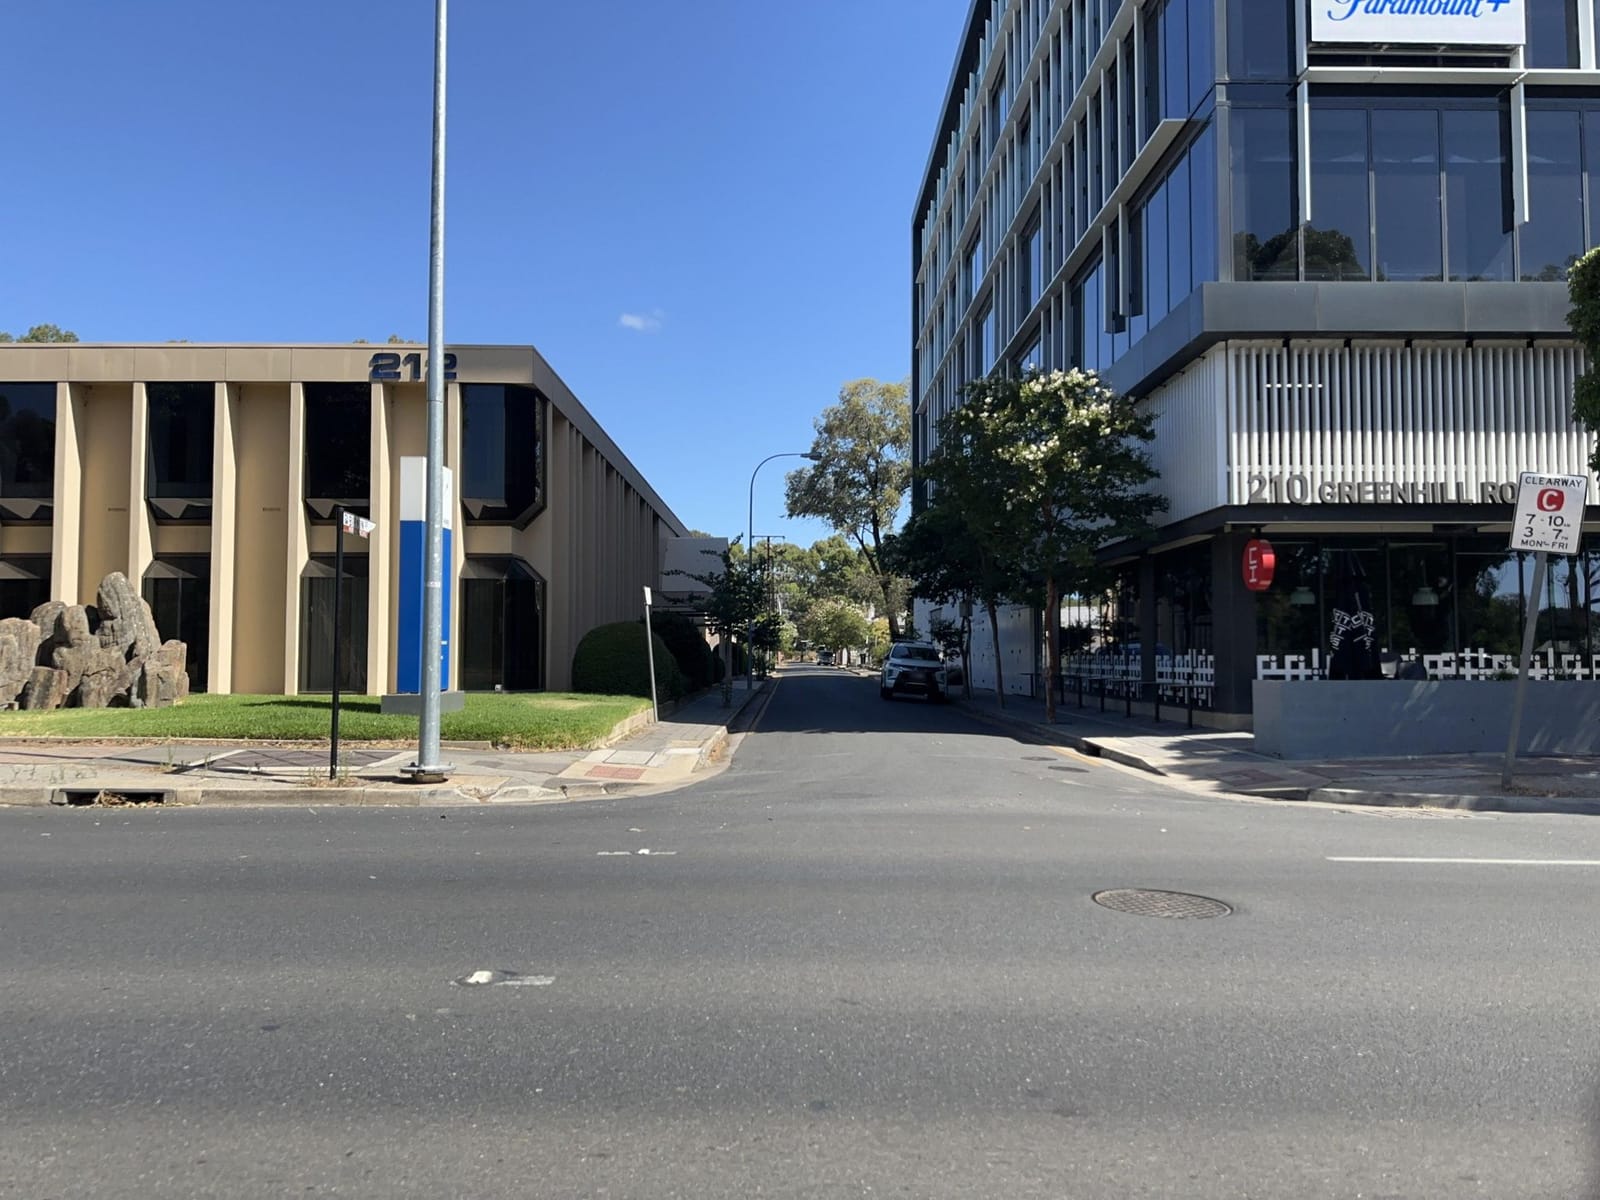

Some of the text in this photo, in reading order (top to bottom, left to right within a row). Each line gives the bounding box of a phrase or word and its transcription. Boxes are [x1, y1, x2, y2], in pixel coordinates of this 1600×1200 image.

[1525, 476, 1582, 488] CLEARWAY
[1248, 474, 1518, 504] 210 GREENHILL RO
[1542, 490, 1558, 510] C
[1525, 513, 1536, 525] 7
[1523, 526, 1534, 538] 3
